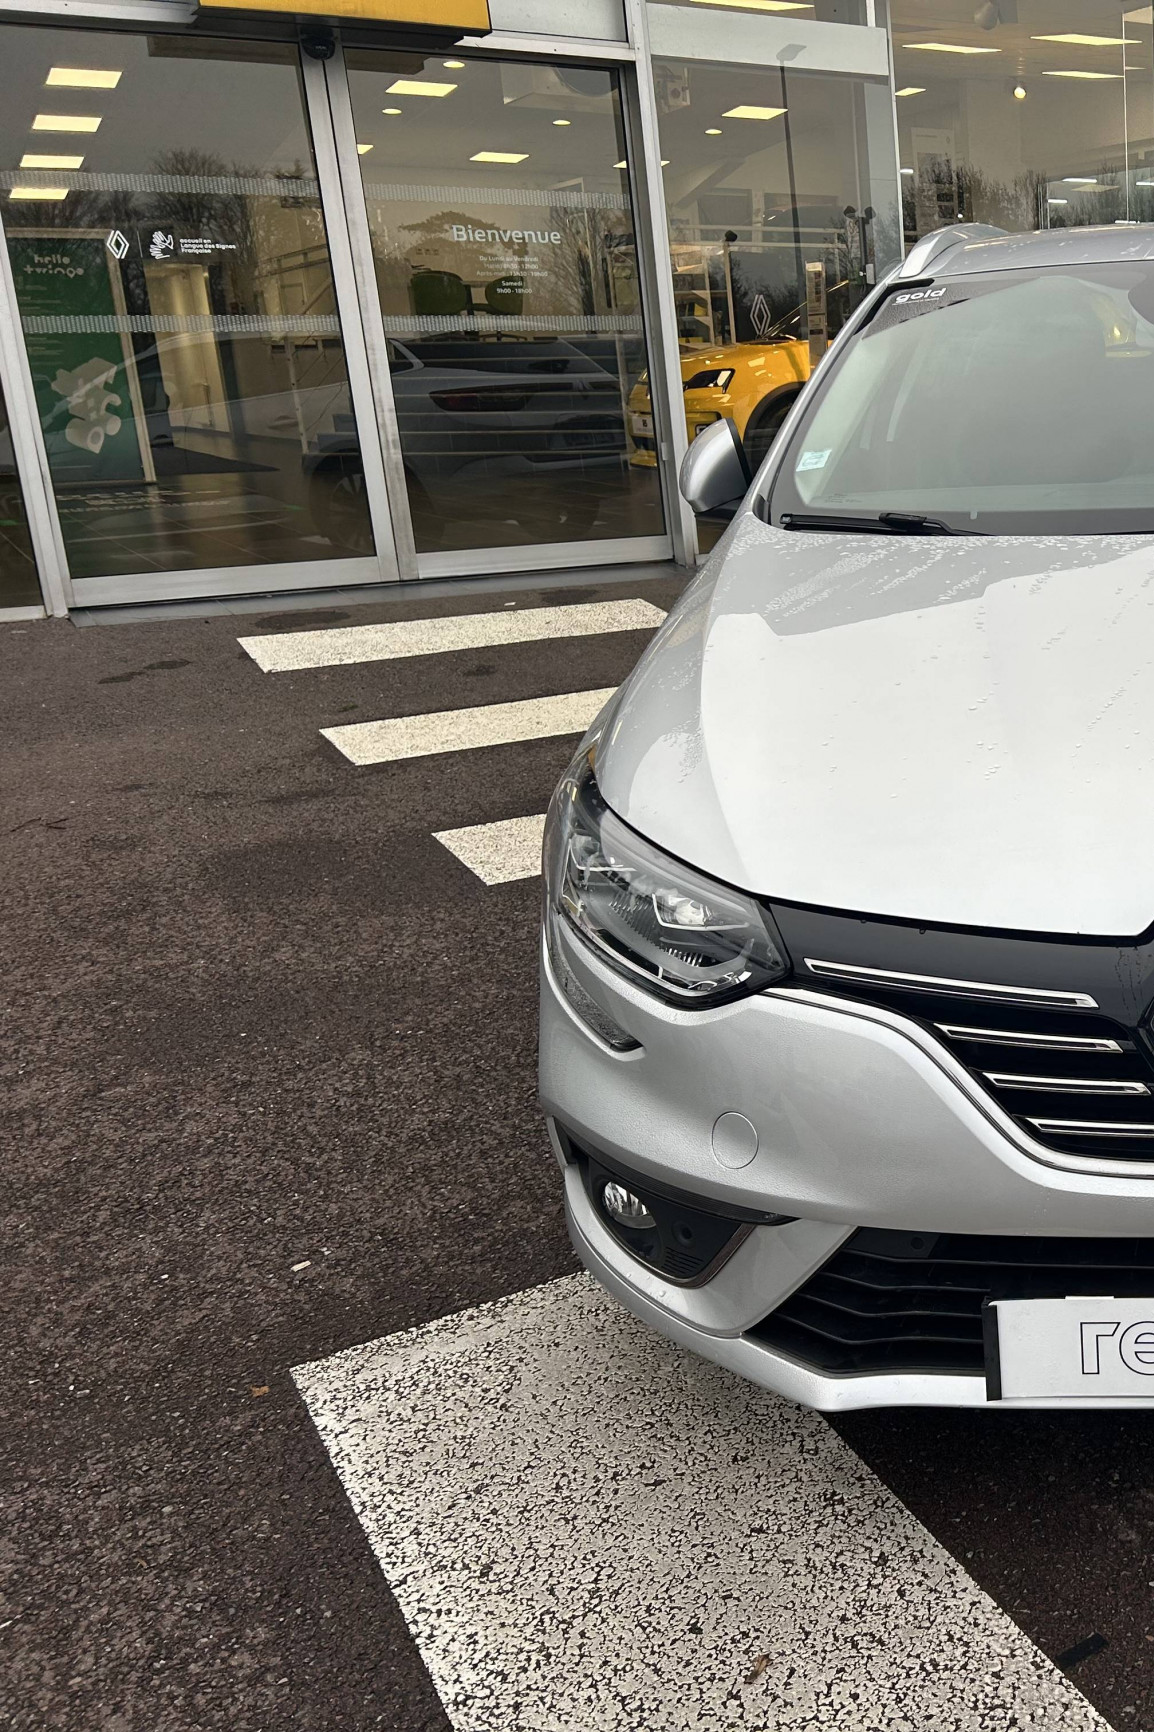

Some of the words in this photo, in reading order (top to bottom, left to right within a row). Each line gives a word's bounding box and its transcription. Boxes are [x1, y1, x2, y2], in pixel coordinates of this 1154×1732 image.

[451, 224, 562, 244] Bienvenue
[34, 254, 71, 265] hello
[895, 287, 947, 304] gold
